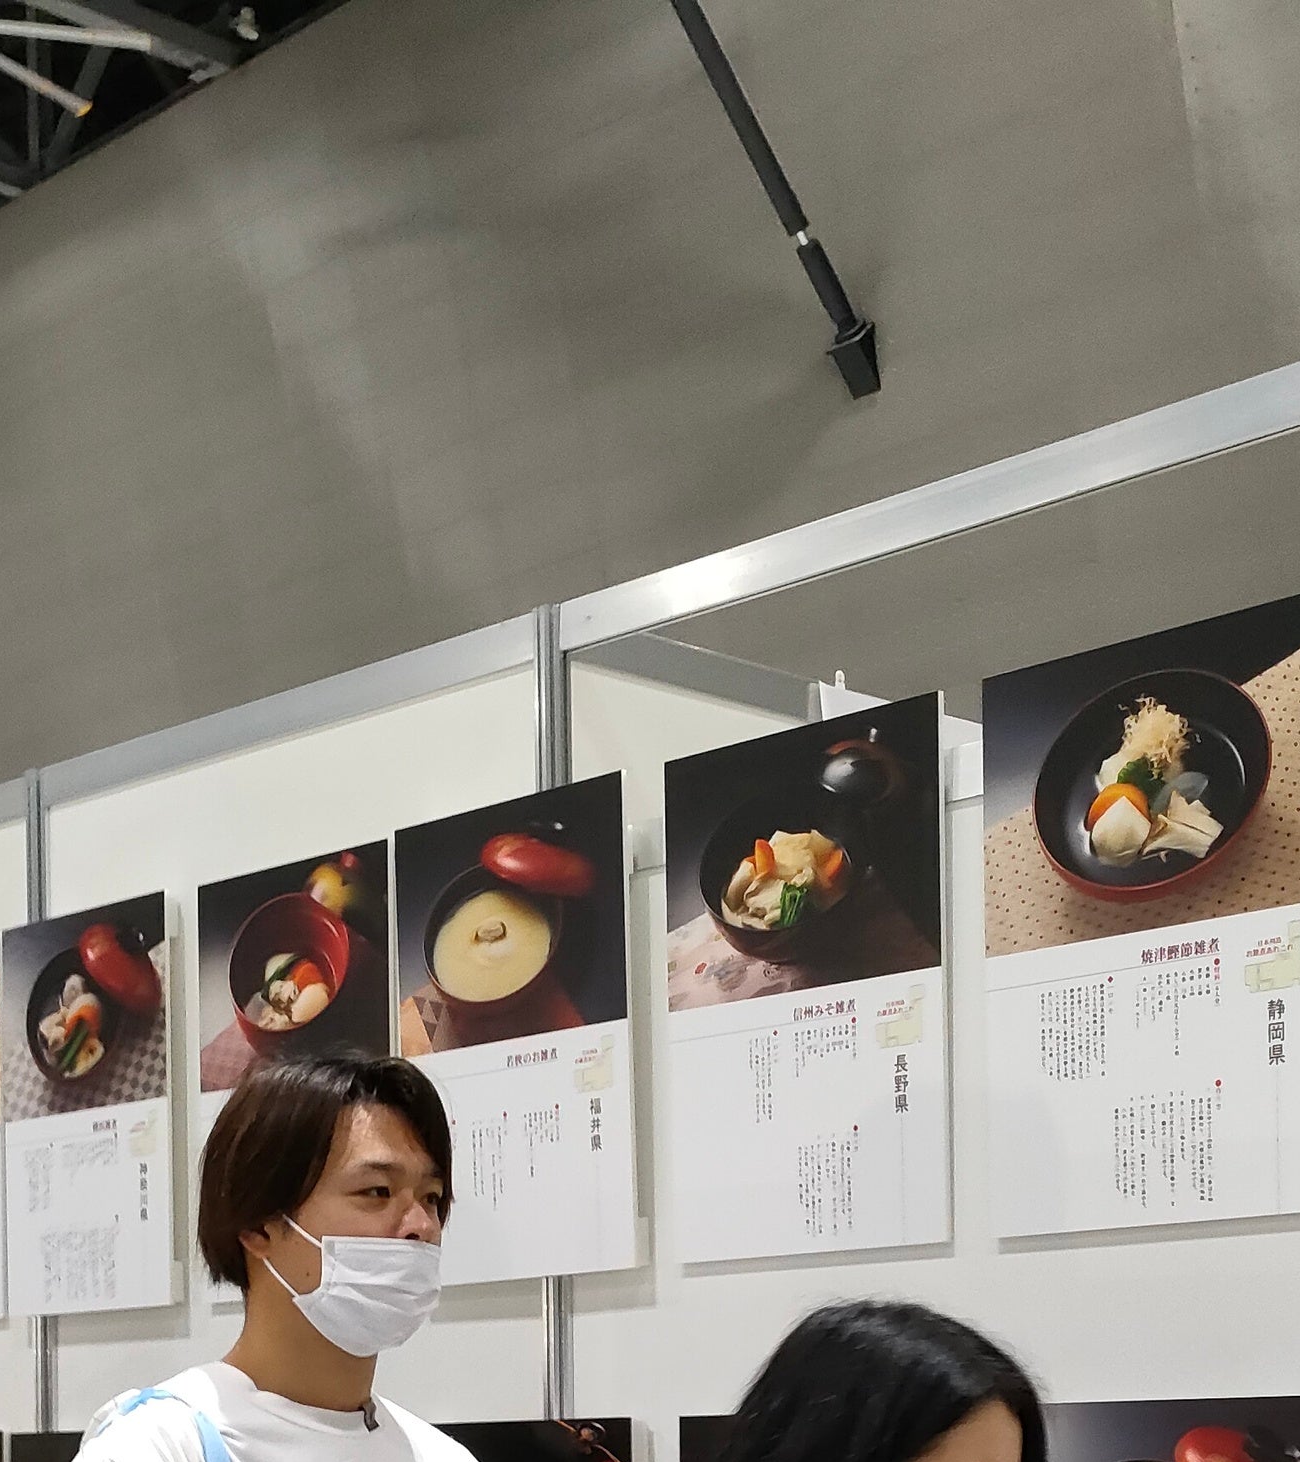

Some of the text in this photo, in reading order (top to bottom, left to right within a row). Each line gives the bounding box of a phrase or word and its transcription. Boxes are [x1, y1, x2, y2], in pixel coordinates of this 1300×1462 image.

[1267, 998, 1287, 1066] 静岡県
[894, 1053, 909, 1113] 長野県
[589, 1098, 603, 1151] 福井県
